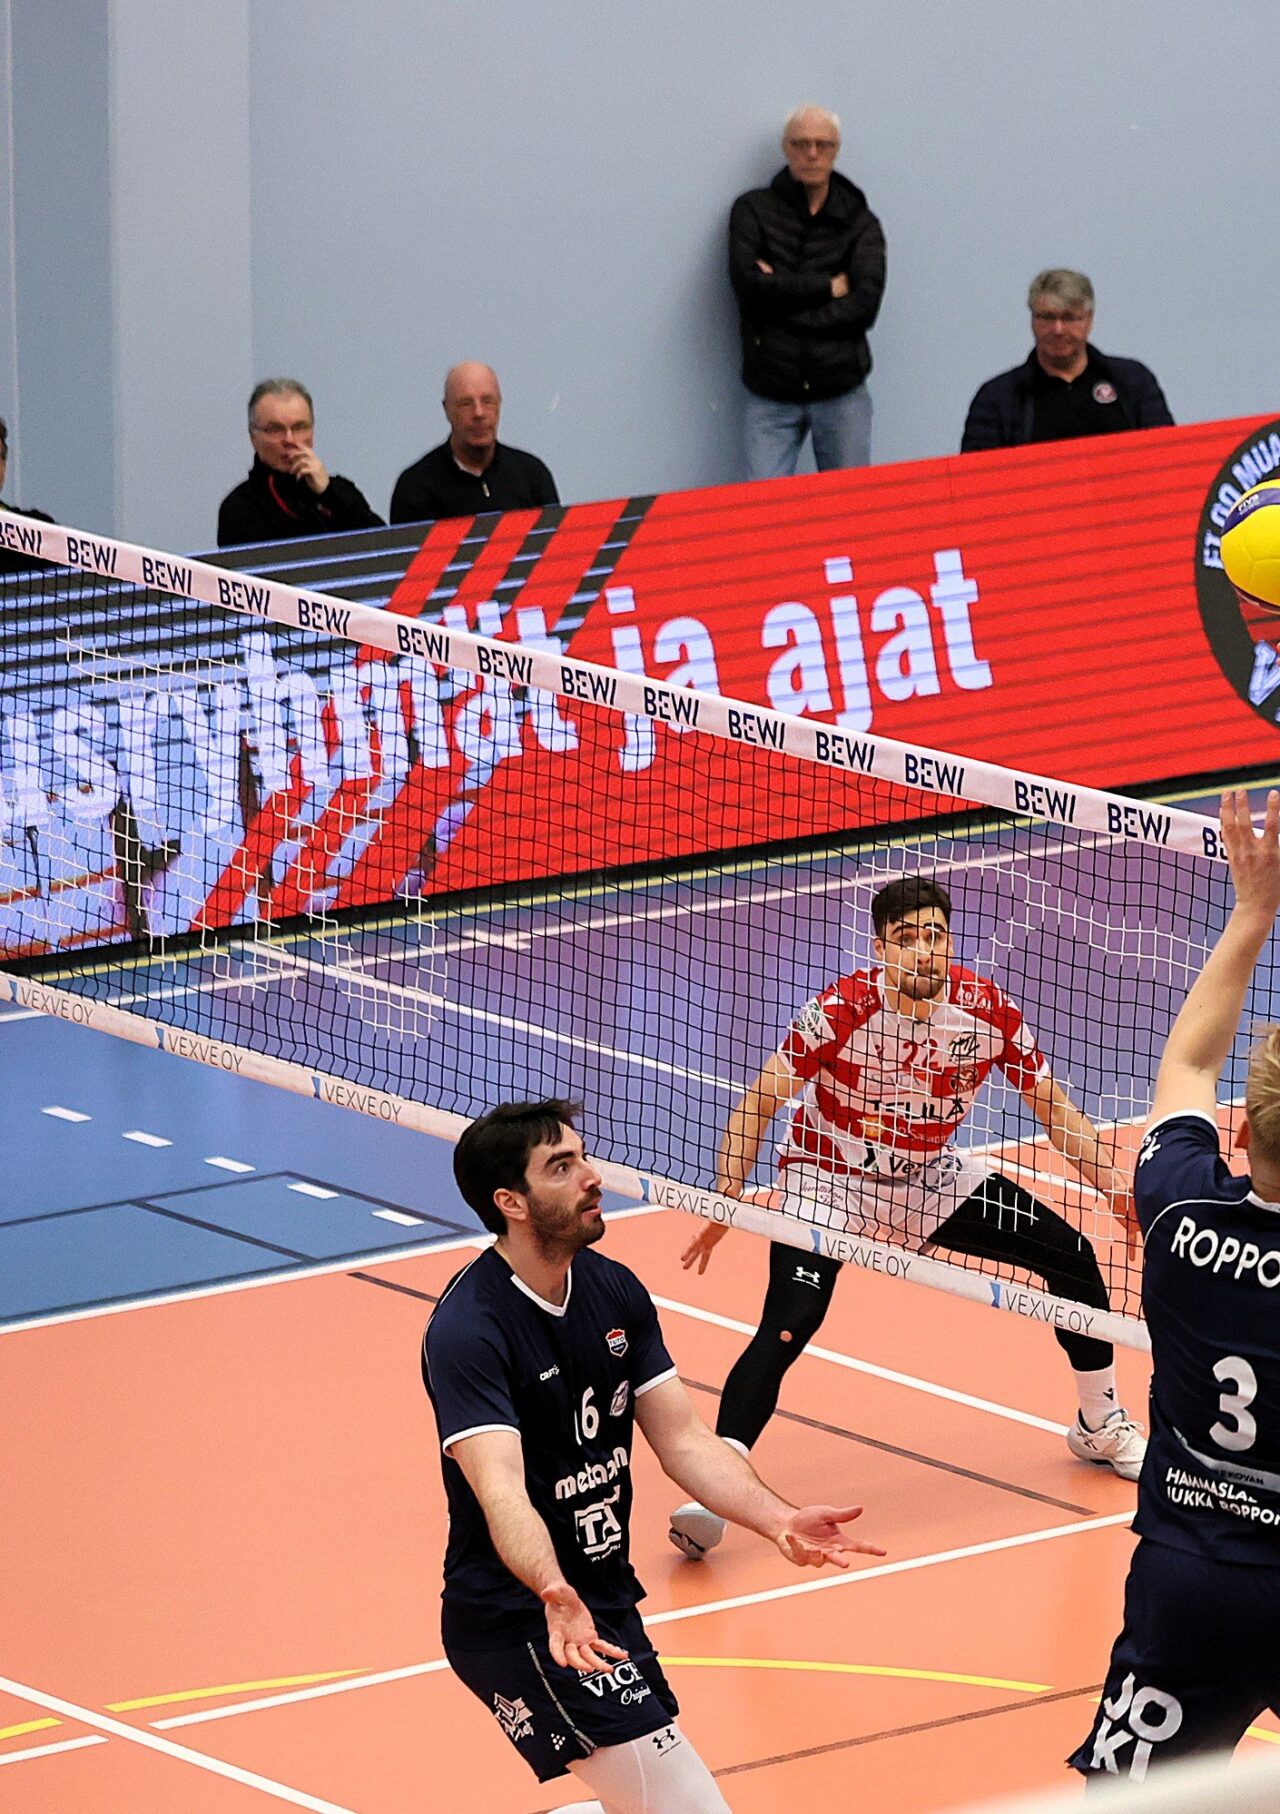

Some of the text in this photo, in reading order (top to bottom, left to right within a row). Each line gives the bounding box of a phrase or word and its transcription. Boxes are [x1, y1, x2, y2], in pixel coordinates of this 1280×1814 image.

[67, 536, 118, 575] BEWI
[142, 559, 193, 596] BEWI
[217, 577, 271, 616] BEWI
[298, 598, 351, 638] BEWI
[397, 624, 450, 667] BEWI
[477, 643, 533, 686] BEWI
[605, 585, 721, 772] ja
[761, 548, 994, 734] ajat
[560, 666, 618, 707] BEWI
[643, 686, 700, 729] BEWI
[728, 709, 786, 751] BEWI
[815, 729, 876, 774] BEWI
[904, 753, 965, 797] BEWI
[1014, 779, 1077, 825] BEWI
[1107, 803, 1172, 846] BEWI
[20, 986, 94, 1026] VEXVE OY
[166, 1034, 244, 1074] VEXVE OY
[325, 1082, 403, 1123] VEXVE OY
[654, 1182, 738, 1225] VEXVE OY
[825, 1235, 912, 1280] VEXVE OY
[1004, 1289, 1095, 1335] VEXVE OY
[1209, 1355, 1258, 1452] 3
